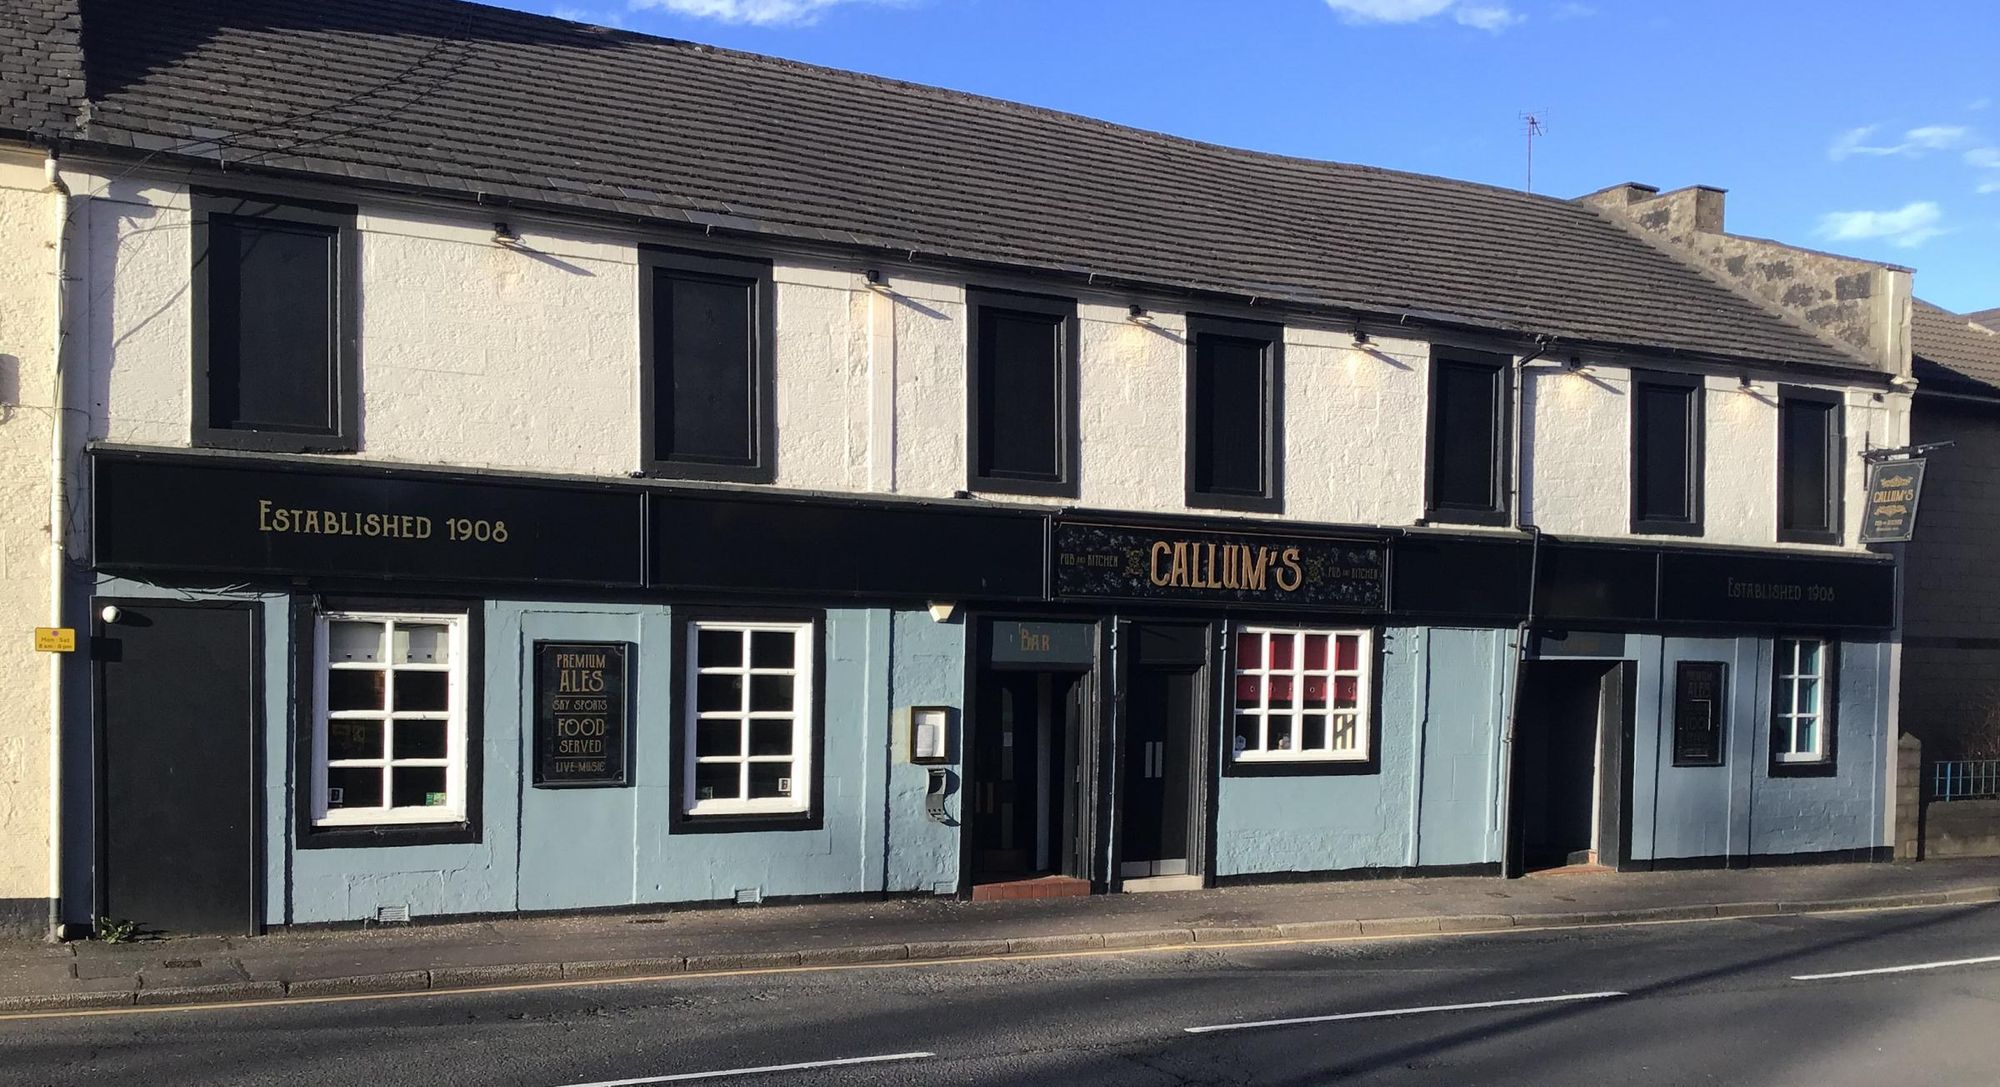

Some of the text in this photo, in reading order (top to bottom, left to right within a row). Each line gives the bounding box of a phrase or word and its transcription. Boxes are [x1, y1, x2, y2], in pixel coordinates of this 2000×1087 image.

[1873, 489, 1914, 503] CALLUM'S
[258, 499, 509, 543] ESTABLISHED 1908
[1060, 553, 1075, 566] PUB
[1087, 554, 1118, 567] KITCHEN
[1151, 541, 1302, 592] CALLUM'S
[1727, 577, 1835, 602] ESTABLISHED 1908
[556, 654, 606, 669] PREMIUM
[559, 670, 604, 692] ALES
[574, 699, 607, 711] SPORTS
[558, 718, 605, 737] FOOD
[559, 740, 602, 753] SERVED
